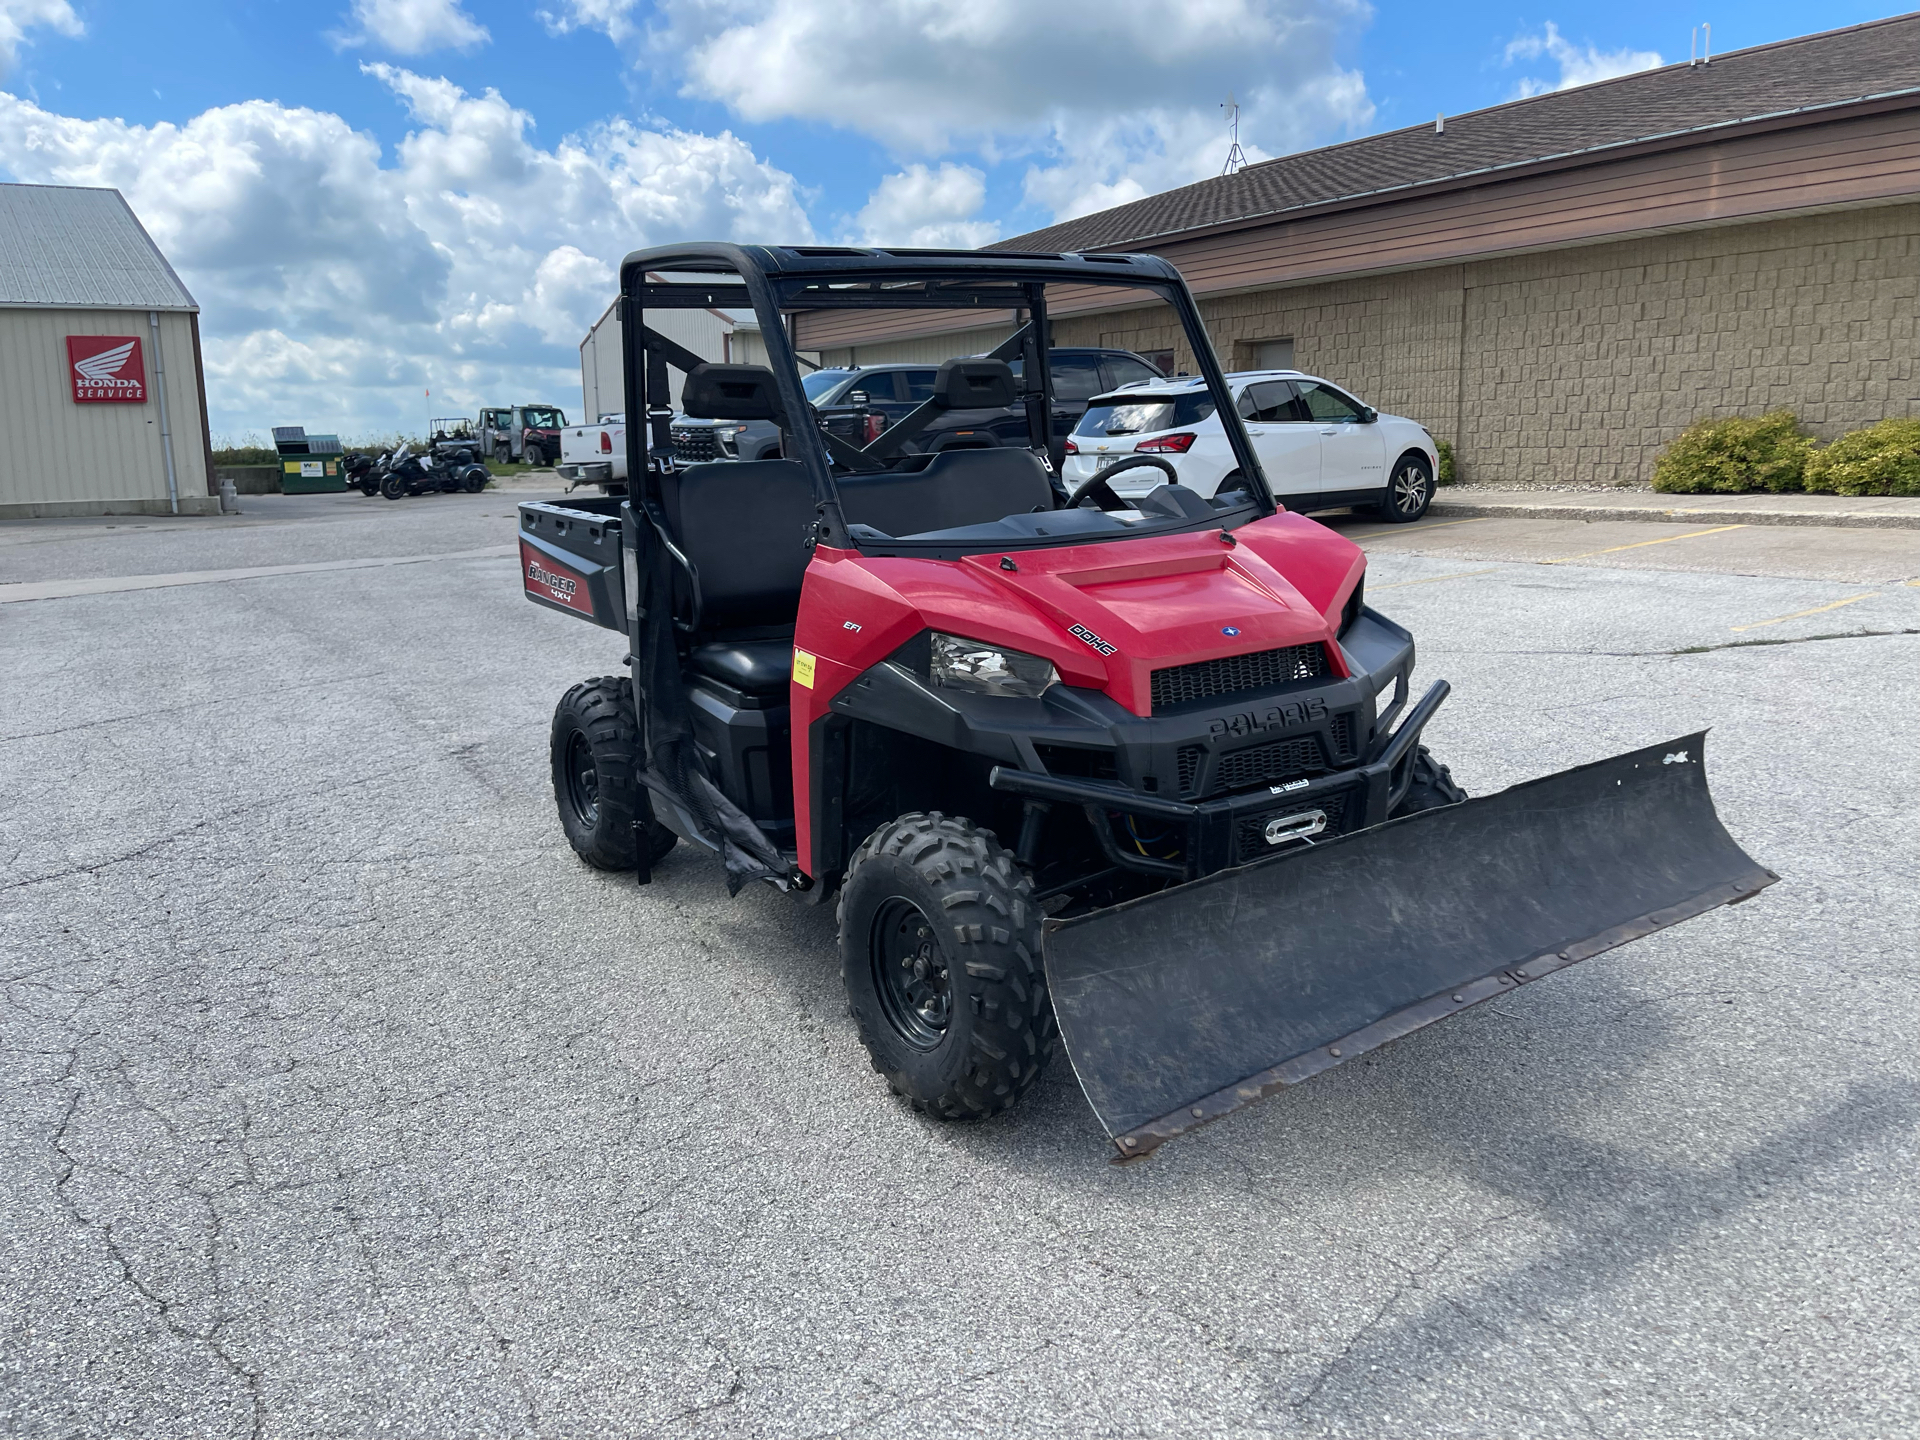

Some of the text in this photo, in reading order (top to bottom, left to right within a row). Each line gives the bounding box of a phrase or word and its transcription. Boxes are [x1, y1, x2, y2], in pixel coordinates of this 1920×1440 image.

[76, 379, 142, 388] HONDA
[77, 389, 143, 398] SERVICE
[528, 564, 577, 595] RANGER
[842, 620, 863, 633] EFI
[1067, 622, 1118, 657] DOHC
[1203, 697, 1329, 743] POLARIS
